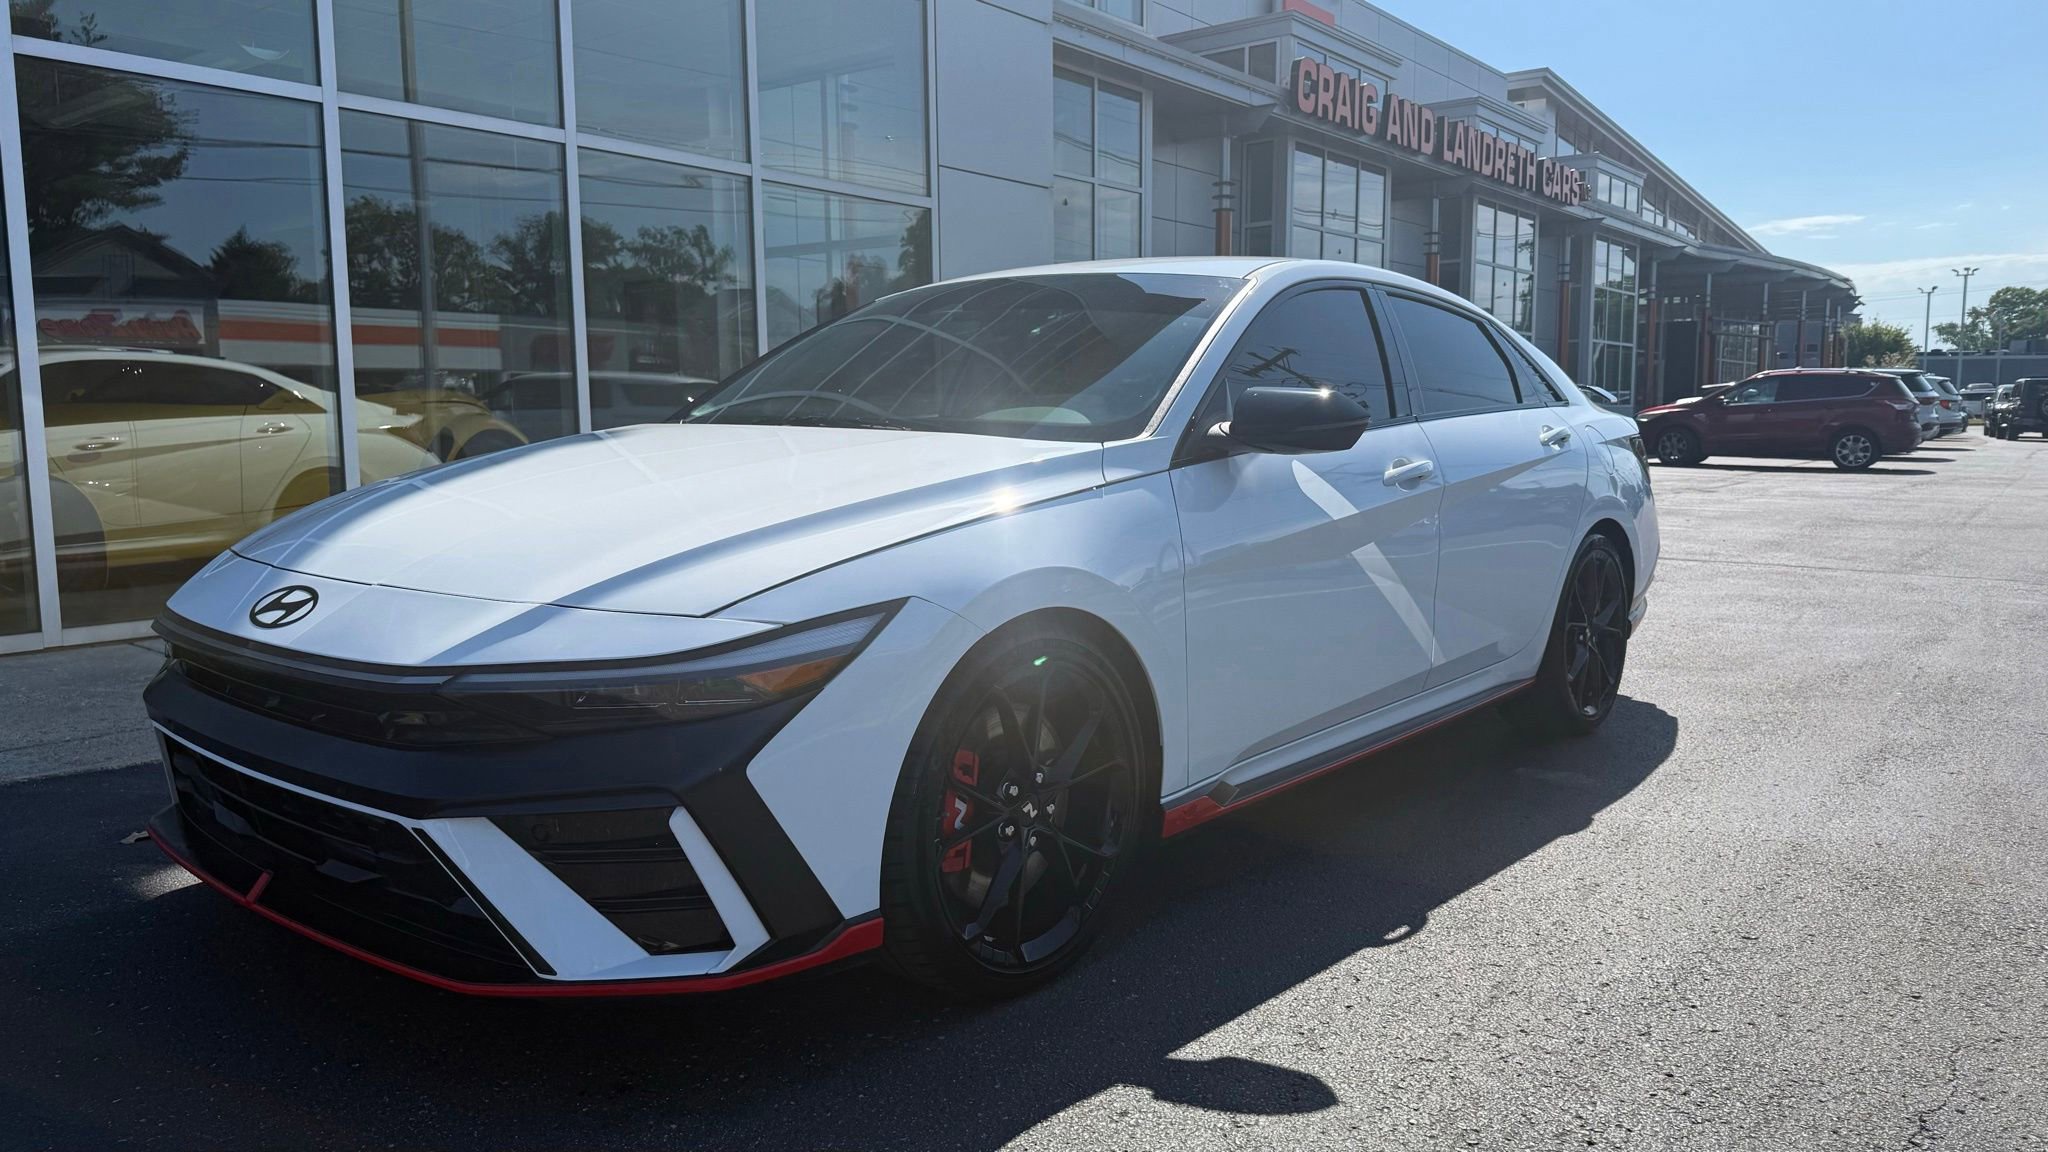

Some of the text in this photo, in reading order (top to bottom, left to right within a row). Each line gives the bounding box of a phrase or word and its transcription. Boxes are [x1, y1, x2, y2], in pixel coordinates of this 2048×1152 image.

[1296, 56, 1580, 206] CRAIG AND LANDRETH CARS
